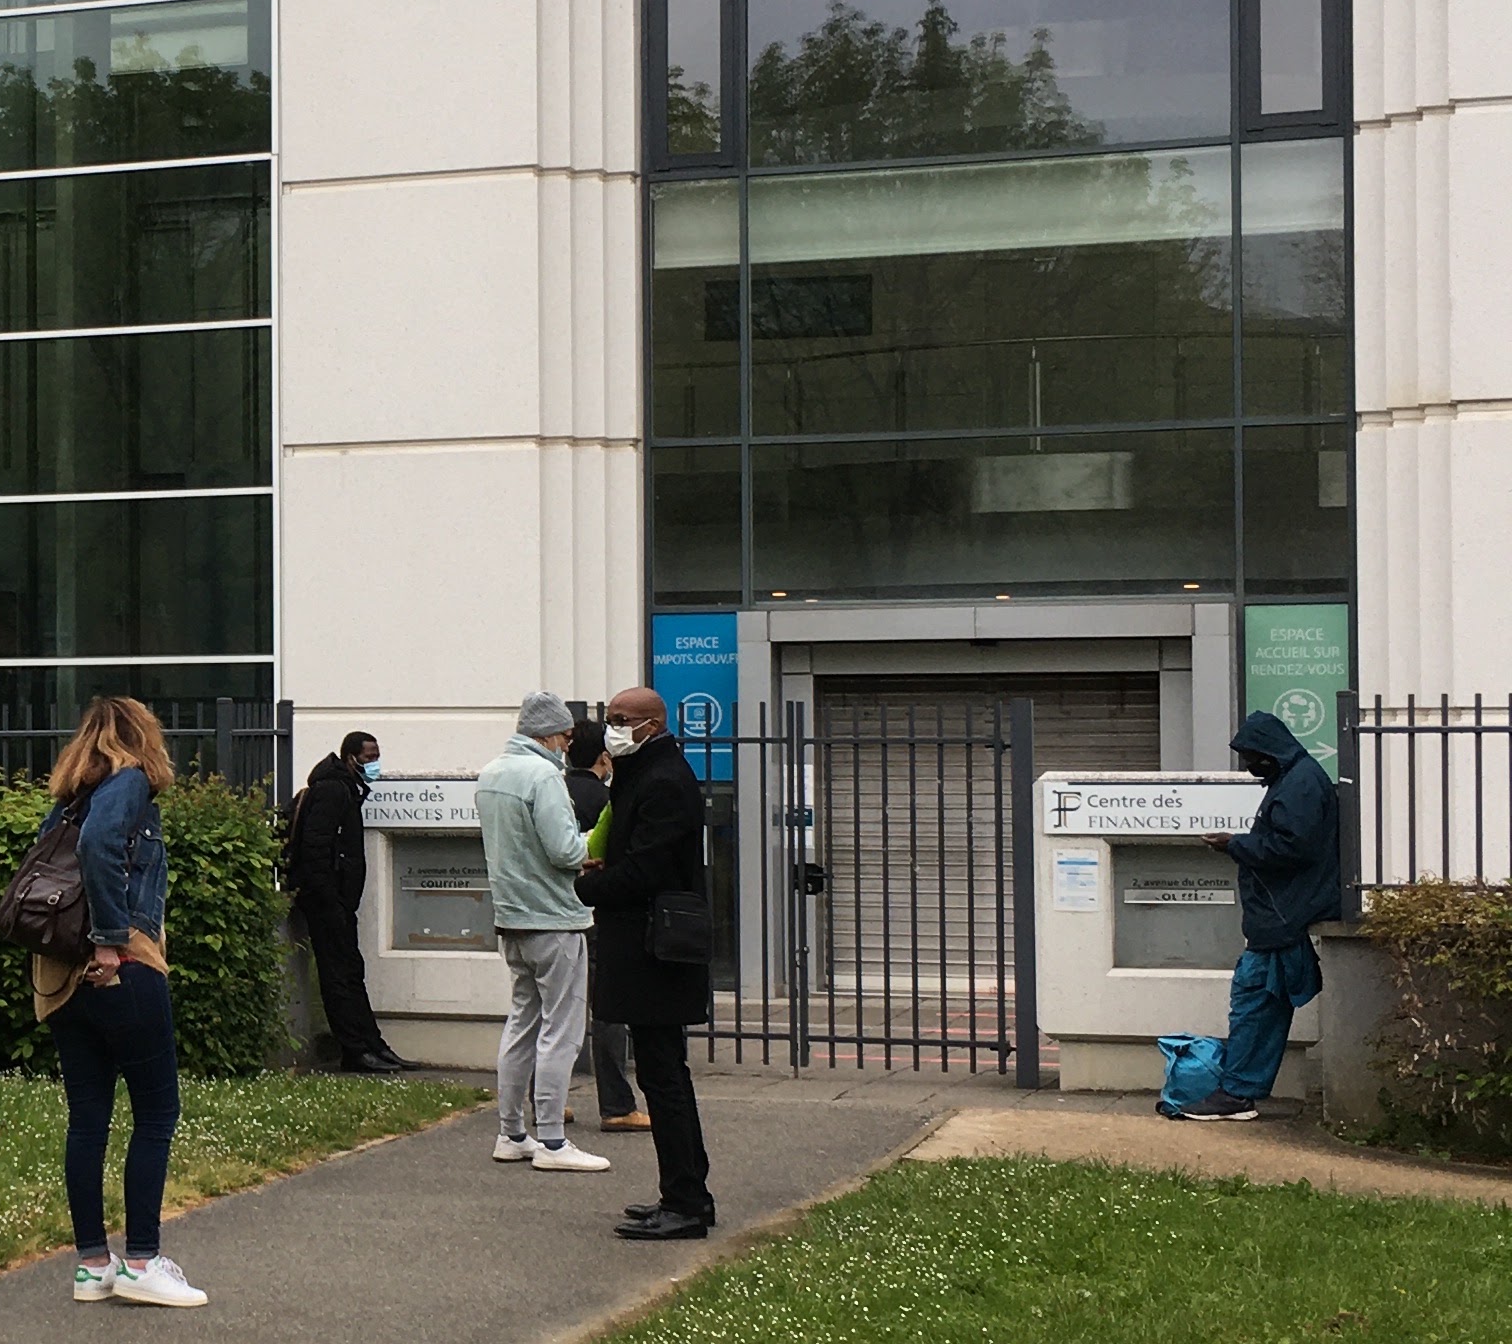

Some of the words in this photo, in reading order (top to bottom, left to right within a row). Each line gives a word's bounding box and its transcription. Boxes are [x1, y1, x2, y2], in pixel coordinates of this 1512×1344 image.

[1270, 628, 1324, 642] ESPACE
[675, 636, 719, 650] ESPACE
[1255, 646, 1311, 659] ACCUEIL
[1313, 646, 1340, 658] SUR
[419, 789, 445, 802] des
[1087, 794, 1147, 808] Centre
[1152, 793, 1183, 808] des
[364, 808, 443, 821] FINANCES
[1088, 815, 1181, 829] FINANCES
[420, 877, 470, 888] courrier
[1182, 878, 1195, 886] du
[1197, 878, 1230, 887] Centre
